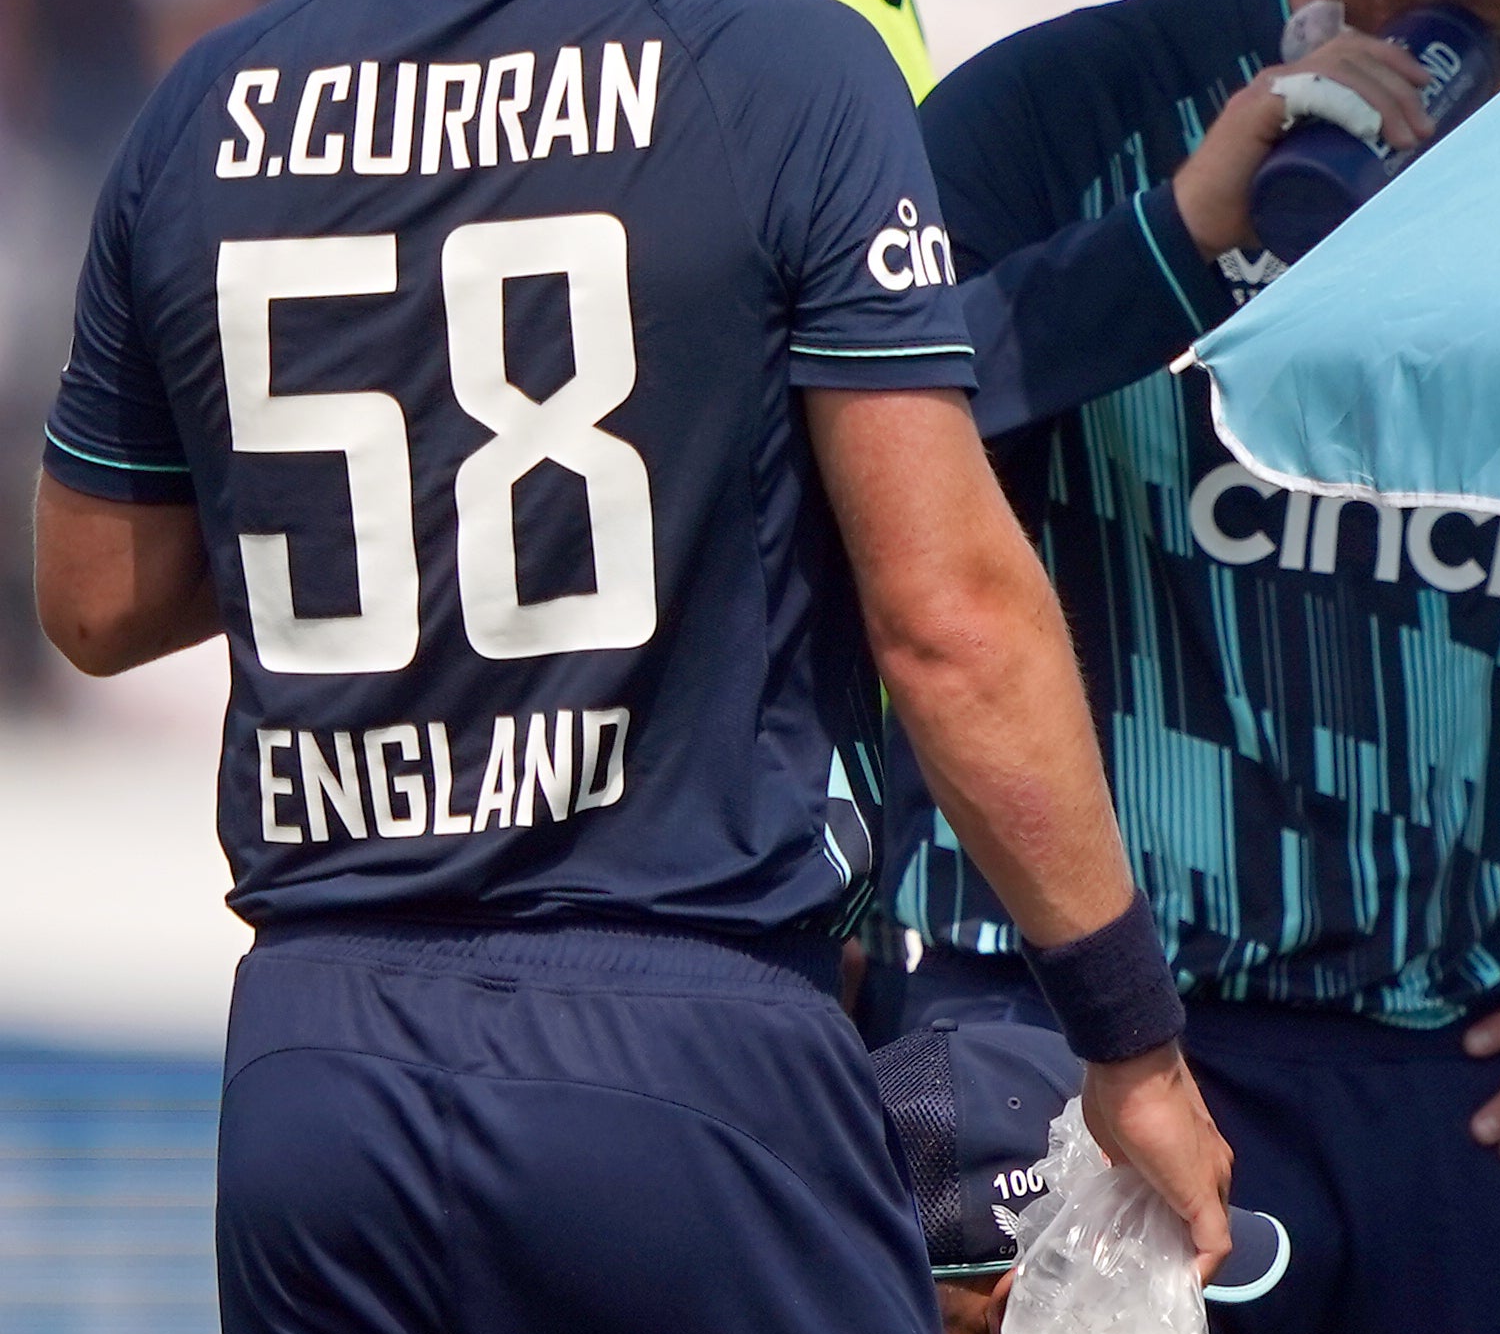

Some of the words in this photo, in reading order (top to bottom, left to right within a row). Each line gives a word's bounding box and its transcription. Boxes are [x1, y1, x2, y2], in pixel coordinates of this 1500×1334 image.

[215, 40, 662, 179] S.CURRAN
[867, 197, 957, 291] cin
[216, 212, 657, 675] 58
[258, 706, 631, 844] ENGLAND
